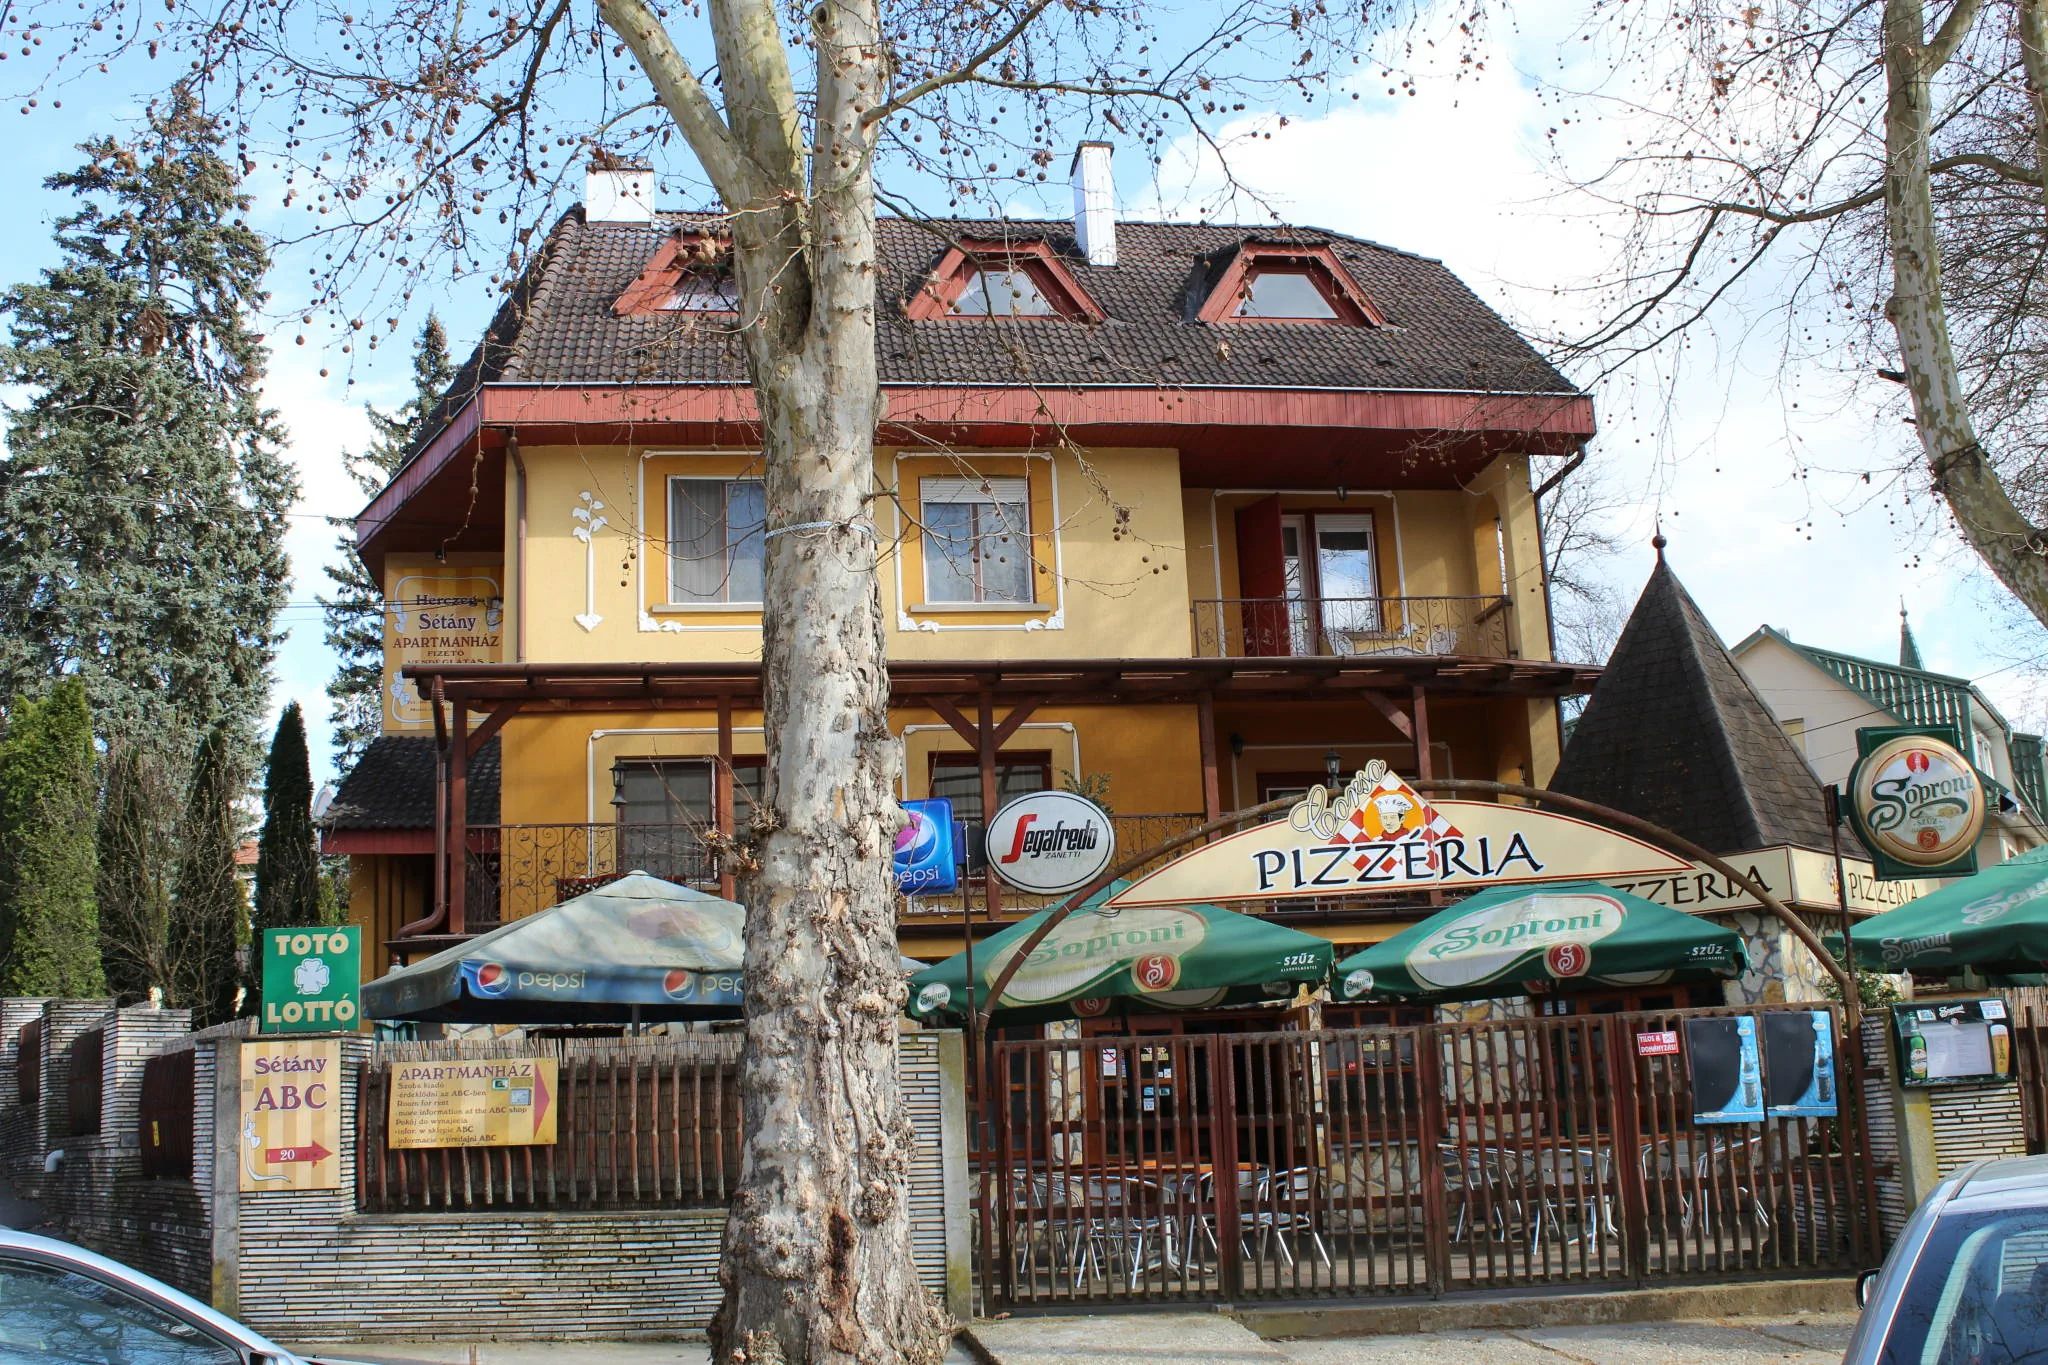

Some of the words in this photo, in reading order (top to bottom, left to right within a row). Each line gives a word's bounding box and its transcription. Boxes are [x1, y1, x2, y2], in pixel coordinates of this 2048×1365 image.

[418, 613, 476, 631] Sétány
[392, 633, 499, 649] APARTMANHÁZ
[1290, 760, 1385, 840] Corso
[1867, 770, 1974, 836] Soproni
[1000, 813, 1099, 864] Segafredo
[1044, 852, 1081, 861] ZANETTI
[1251, 829, 1544, 892] PIZZÉRIA
[275, 927, 349, 956] TOTÓ
[1429, 909, 1603, 959] Soproni
[518, 969, 586, 990] pepsi
[701, 975, 744, 997] pep
[267, 993, 355, 1024] LOTTÓ
[254, 1055, 328, 1075] Sétány
[399, 1061, 532, 1081] APARTMANHÁZ
[253, 1083, 328, 1112] ABC
[508, 1106, 528, 1114] shop
[456, 1125, 474, 1133] ABC
[479, 1134, 496, 1142] ABC
[280, 1149, 296, 1162] 20
